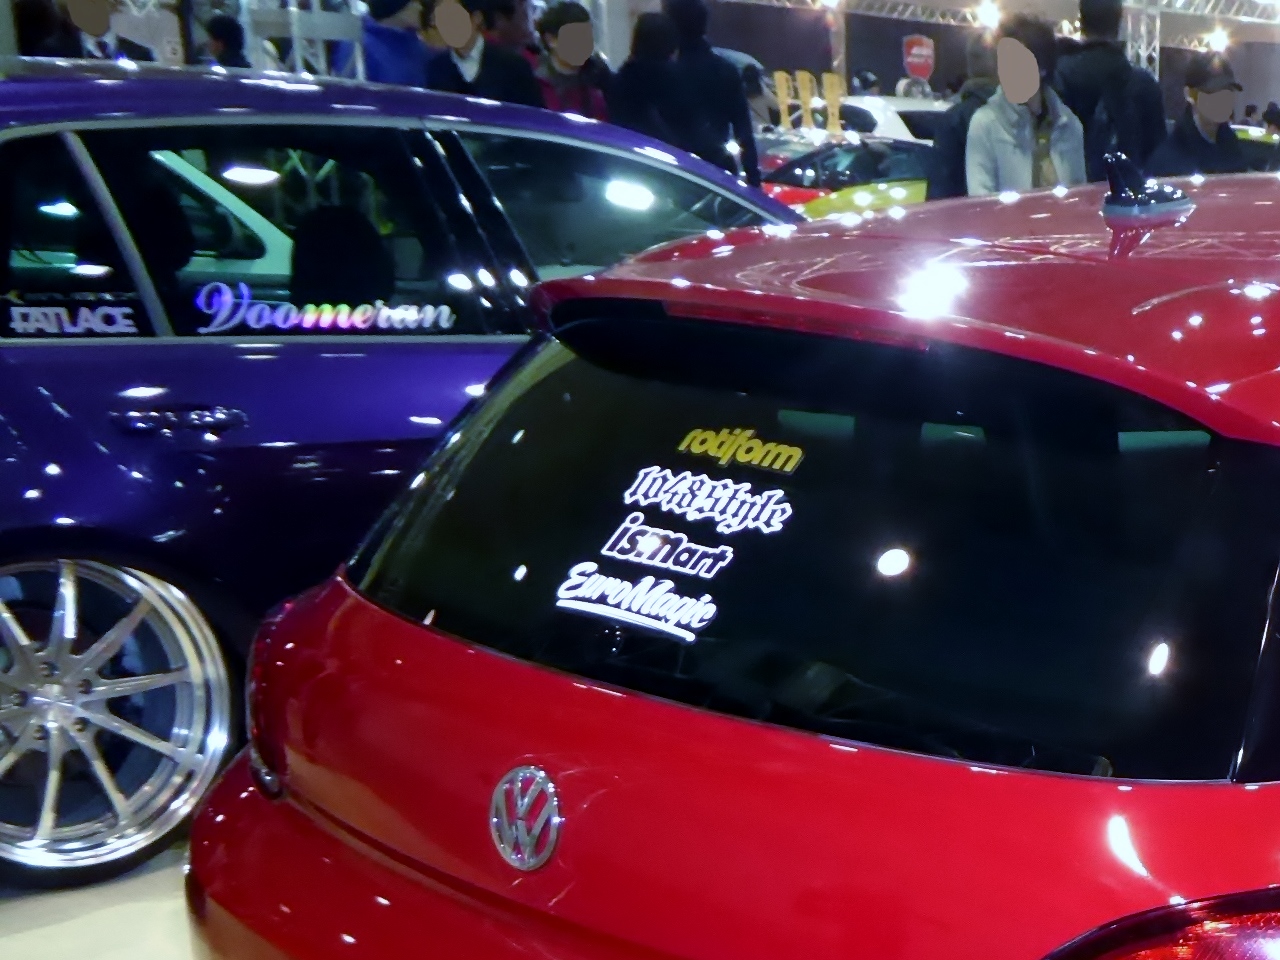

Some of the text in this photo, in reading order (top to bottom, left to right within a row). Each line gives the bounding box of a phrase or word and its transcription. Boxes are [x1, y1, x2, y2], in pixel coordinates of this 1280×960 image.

[197, 281, 457, 334] Voomeran
[678, 428, 804, 474] rotiform
[556, 562, 717, 630] EuroMagic
